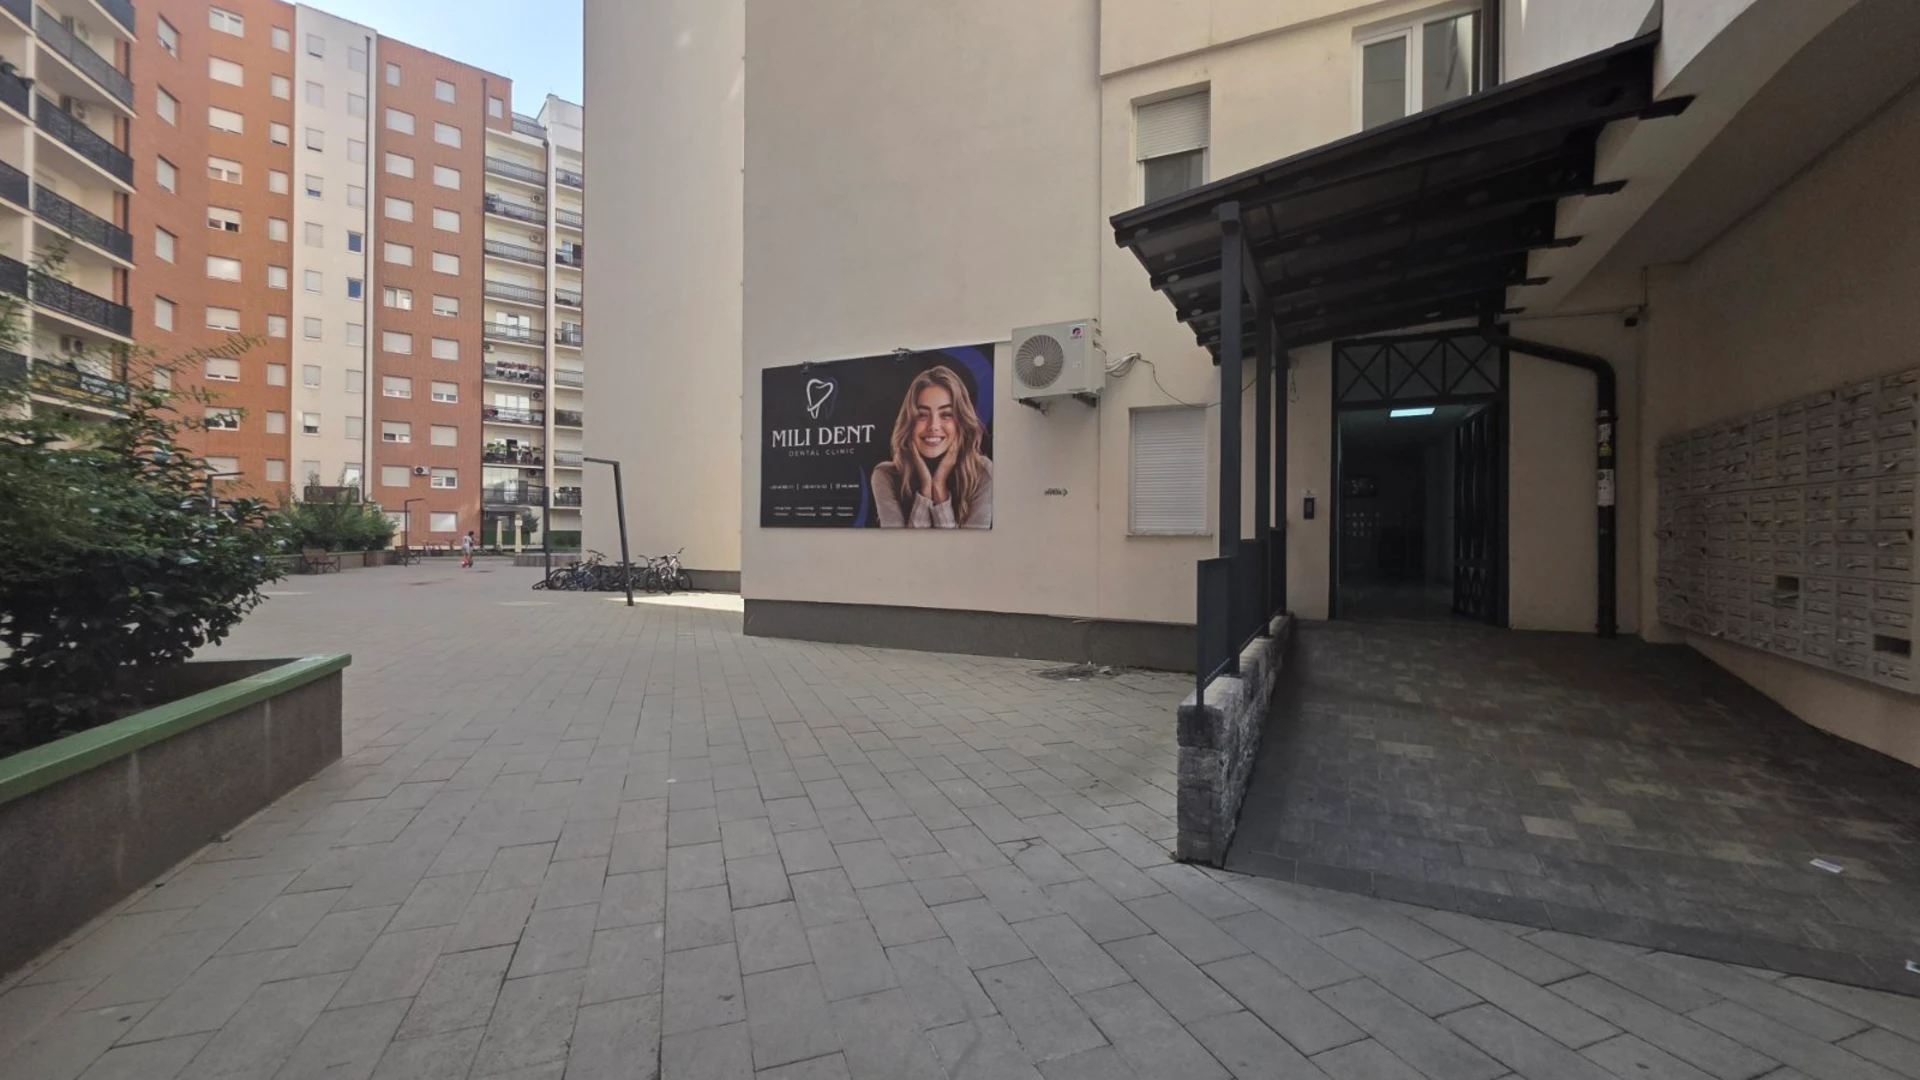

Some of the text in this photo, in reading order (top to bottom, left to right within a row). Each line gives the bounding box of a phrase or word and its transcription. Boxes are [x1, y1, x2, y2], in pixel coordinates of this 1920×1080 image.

[772, 424, 876, 448] MILI DENT
[788, 449, 820, 457] DENTAL
